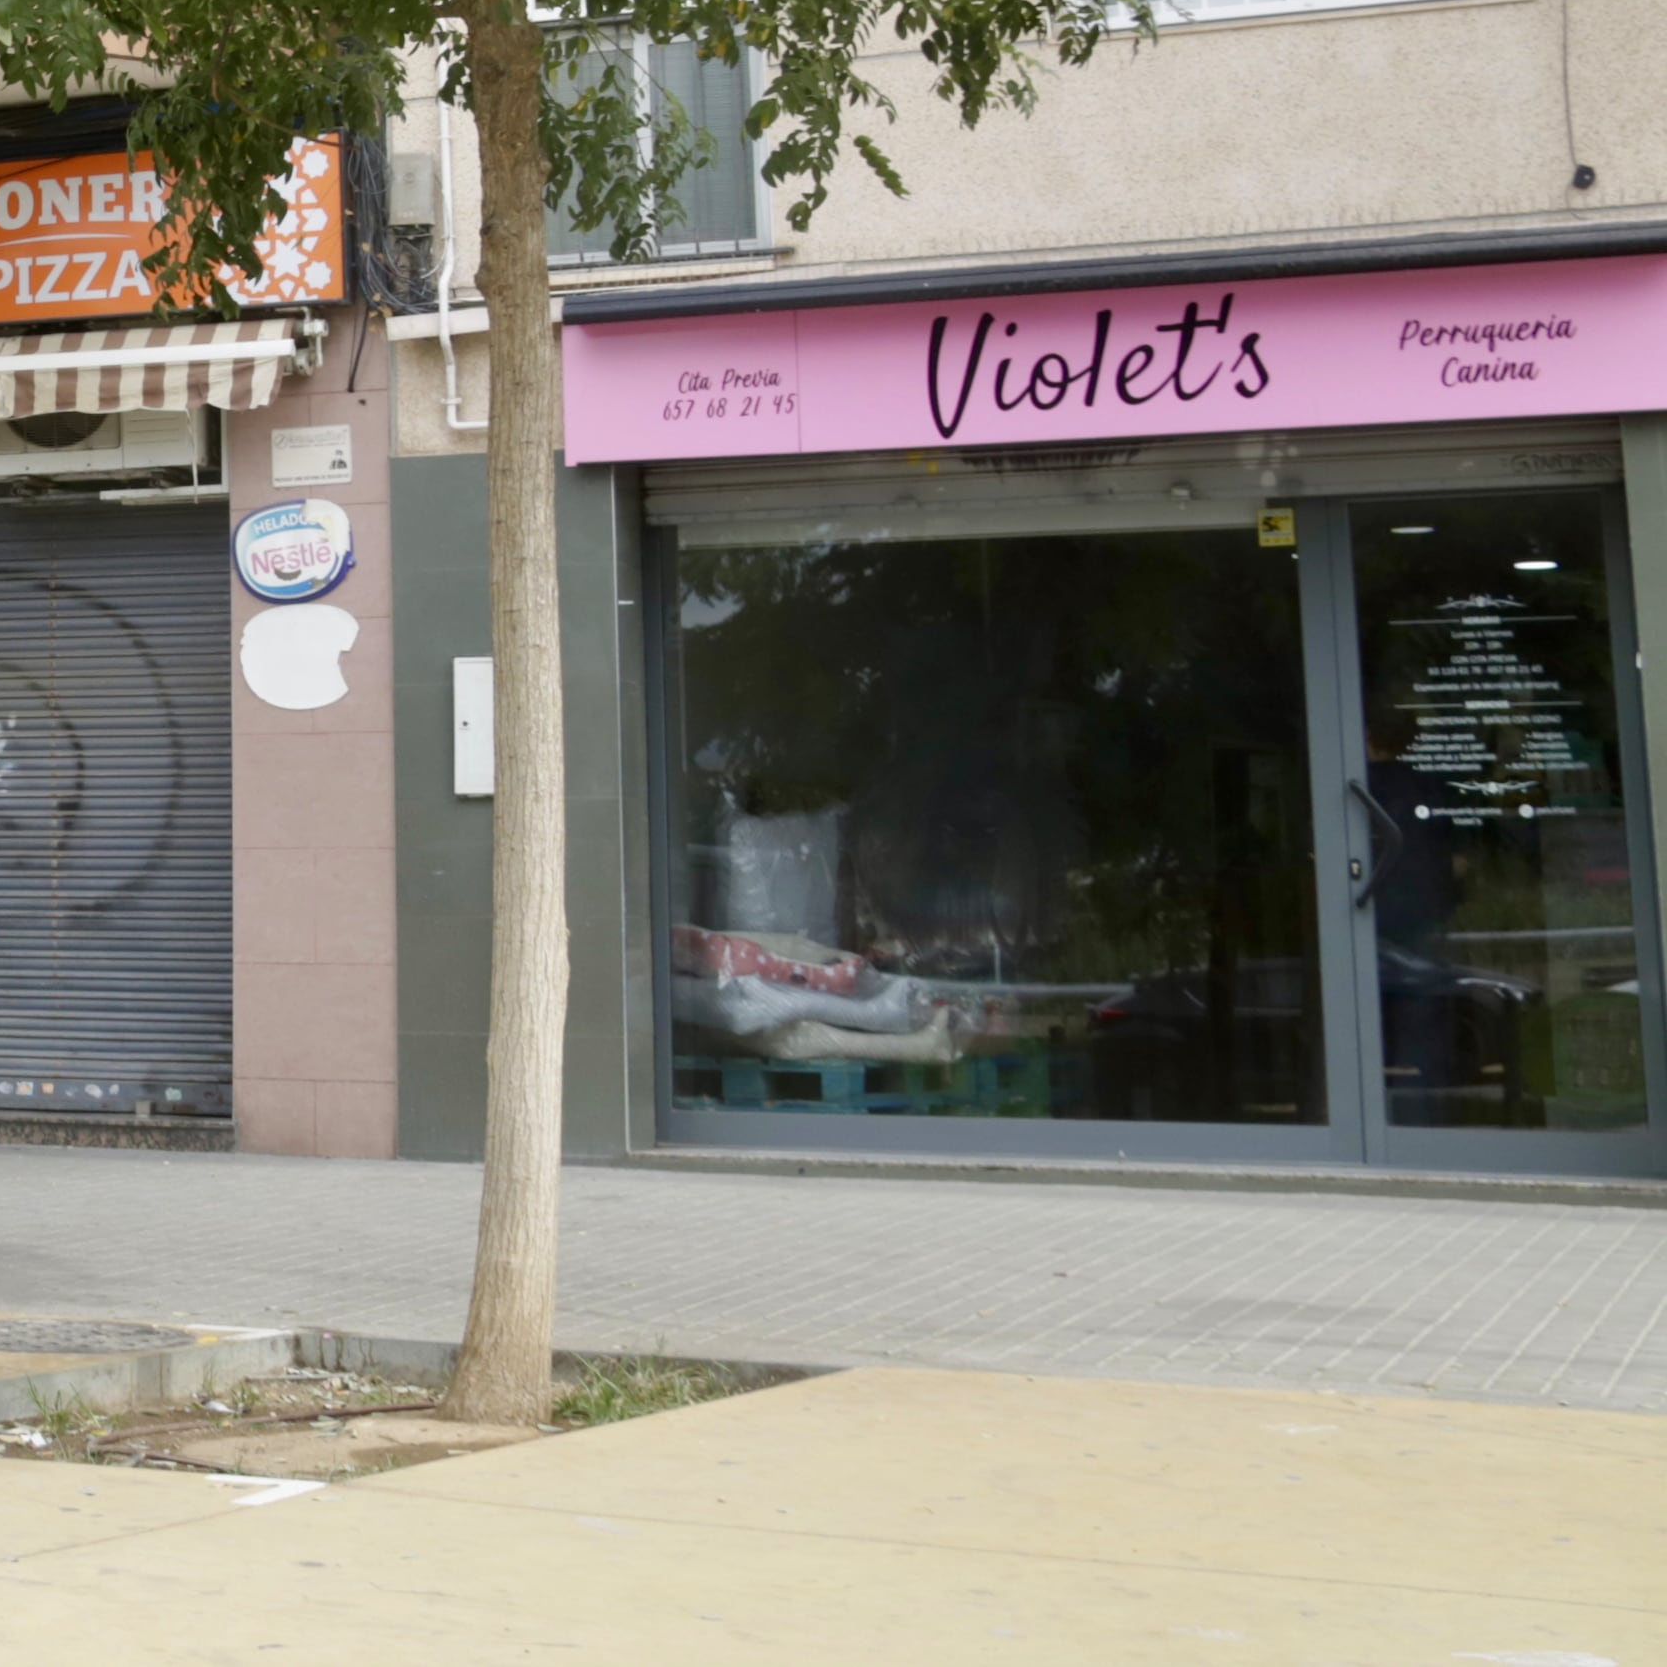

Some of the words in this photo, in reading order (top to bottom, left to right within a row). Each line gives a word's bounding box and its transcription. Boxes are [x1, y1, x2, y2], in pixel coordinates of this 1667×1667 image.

[1399, 314, 1576, 353] Perruqueria
[678, 371, 710, 394] Cita
[721, 368, 780, 391] Previa
[926, 293, 1271, 440] Violet's
[1441, 356, 1539, 387] Canina
[663, 399, 695, 421] 657
[707, 397, 728, 418] 68
[740, 395, 761, 417] 21
[773, 393, 797, 414] 45
